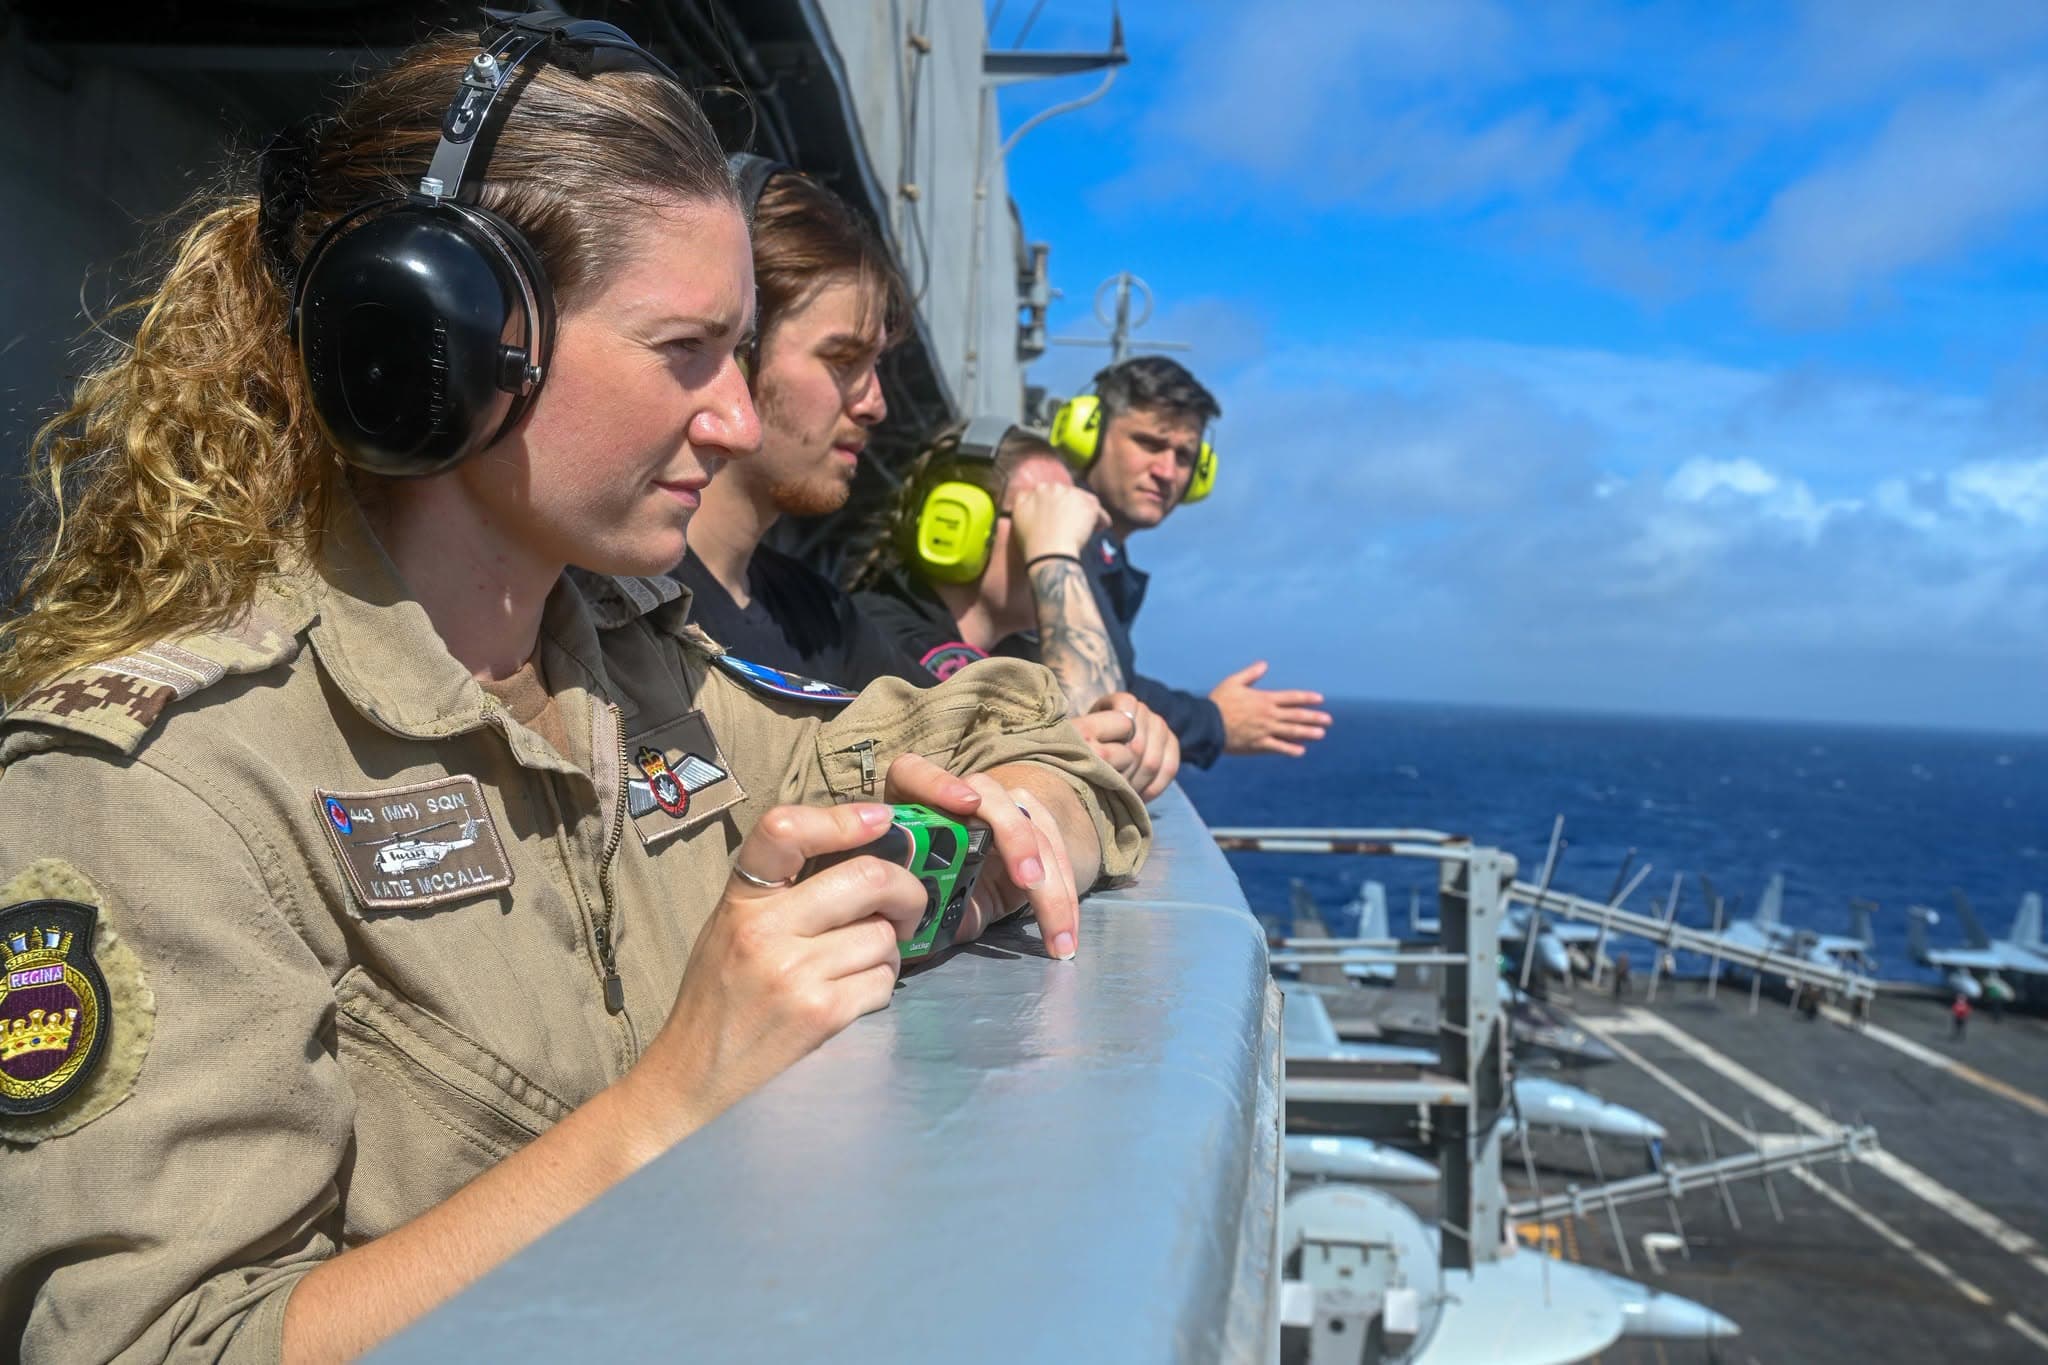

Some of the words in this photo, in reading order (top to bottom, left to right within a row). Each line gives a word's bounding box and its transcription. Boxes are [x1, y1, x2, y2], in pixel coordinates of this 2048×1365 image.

[350, 807, 375, 823] 443
[381, 802, 419, 823] (MH)
[426, 792, 468, 814] SQN
[370, 879, 415, 898] KATIE
[416, 865, 494, 895] MCCALL
[11, 966, 64, 988] REGINA
